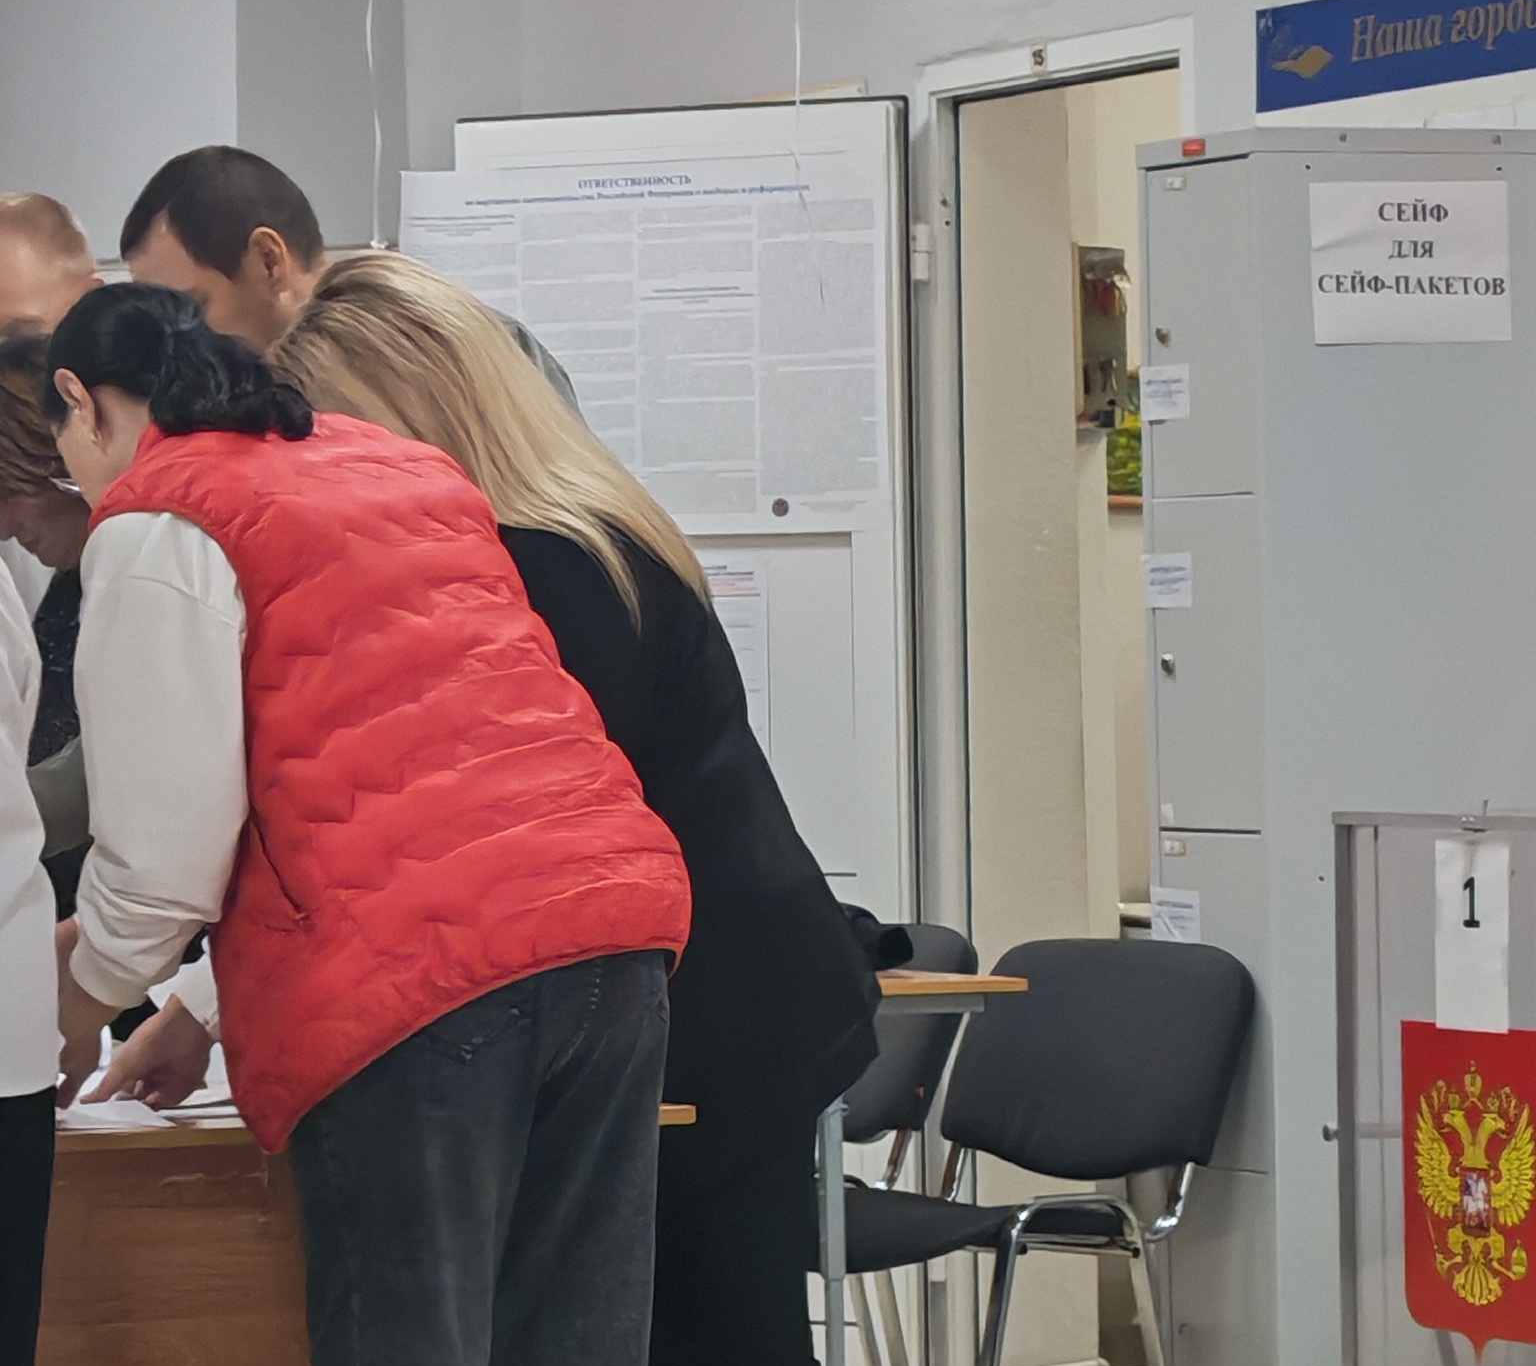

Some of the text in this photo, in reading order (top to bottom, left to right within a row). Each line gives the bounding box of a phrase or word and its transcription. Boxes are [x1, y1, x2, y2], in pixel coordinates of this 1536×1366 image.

[1351, 14, 1444, 62] Наша
[577, 174, 692, 190] ОТВЕТСТВЕННОСТЬ
[1378, 198, 1449, 223] СЕЙФ
[1387, 240, 1434, 260] ДЛЯ
[1317, 269, 1506, 296] СЕЙФ-ПАКЕТОВ
[1463, 876, 1480, 928] 1
